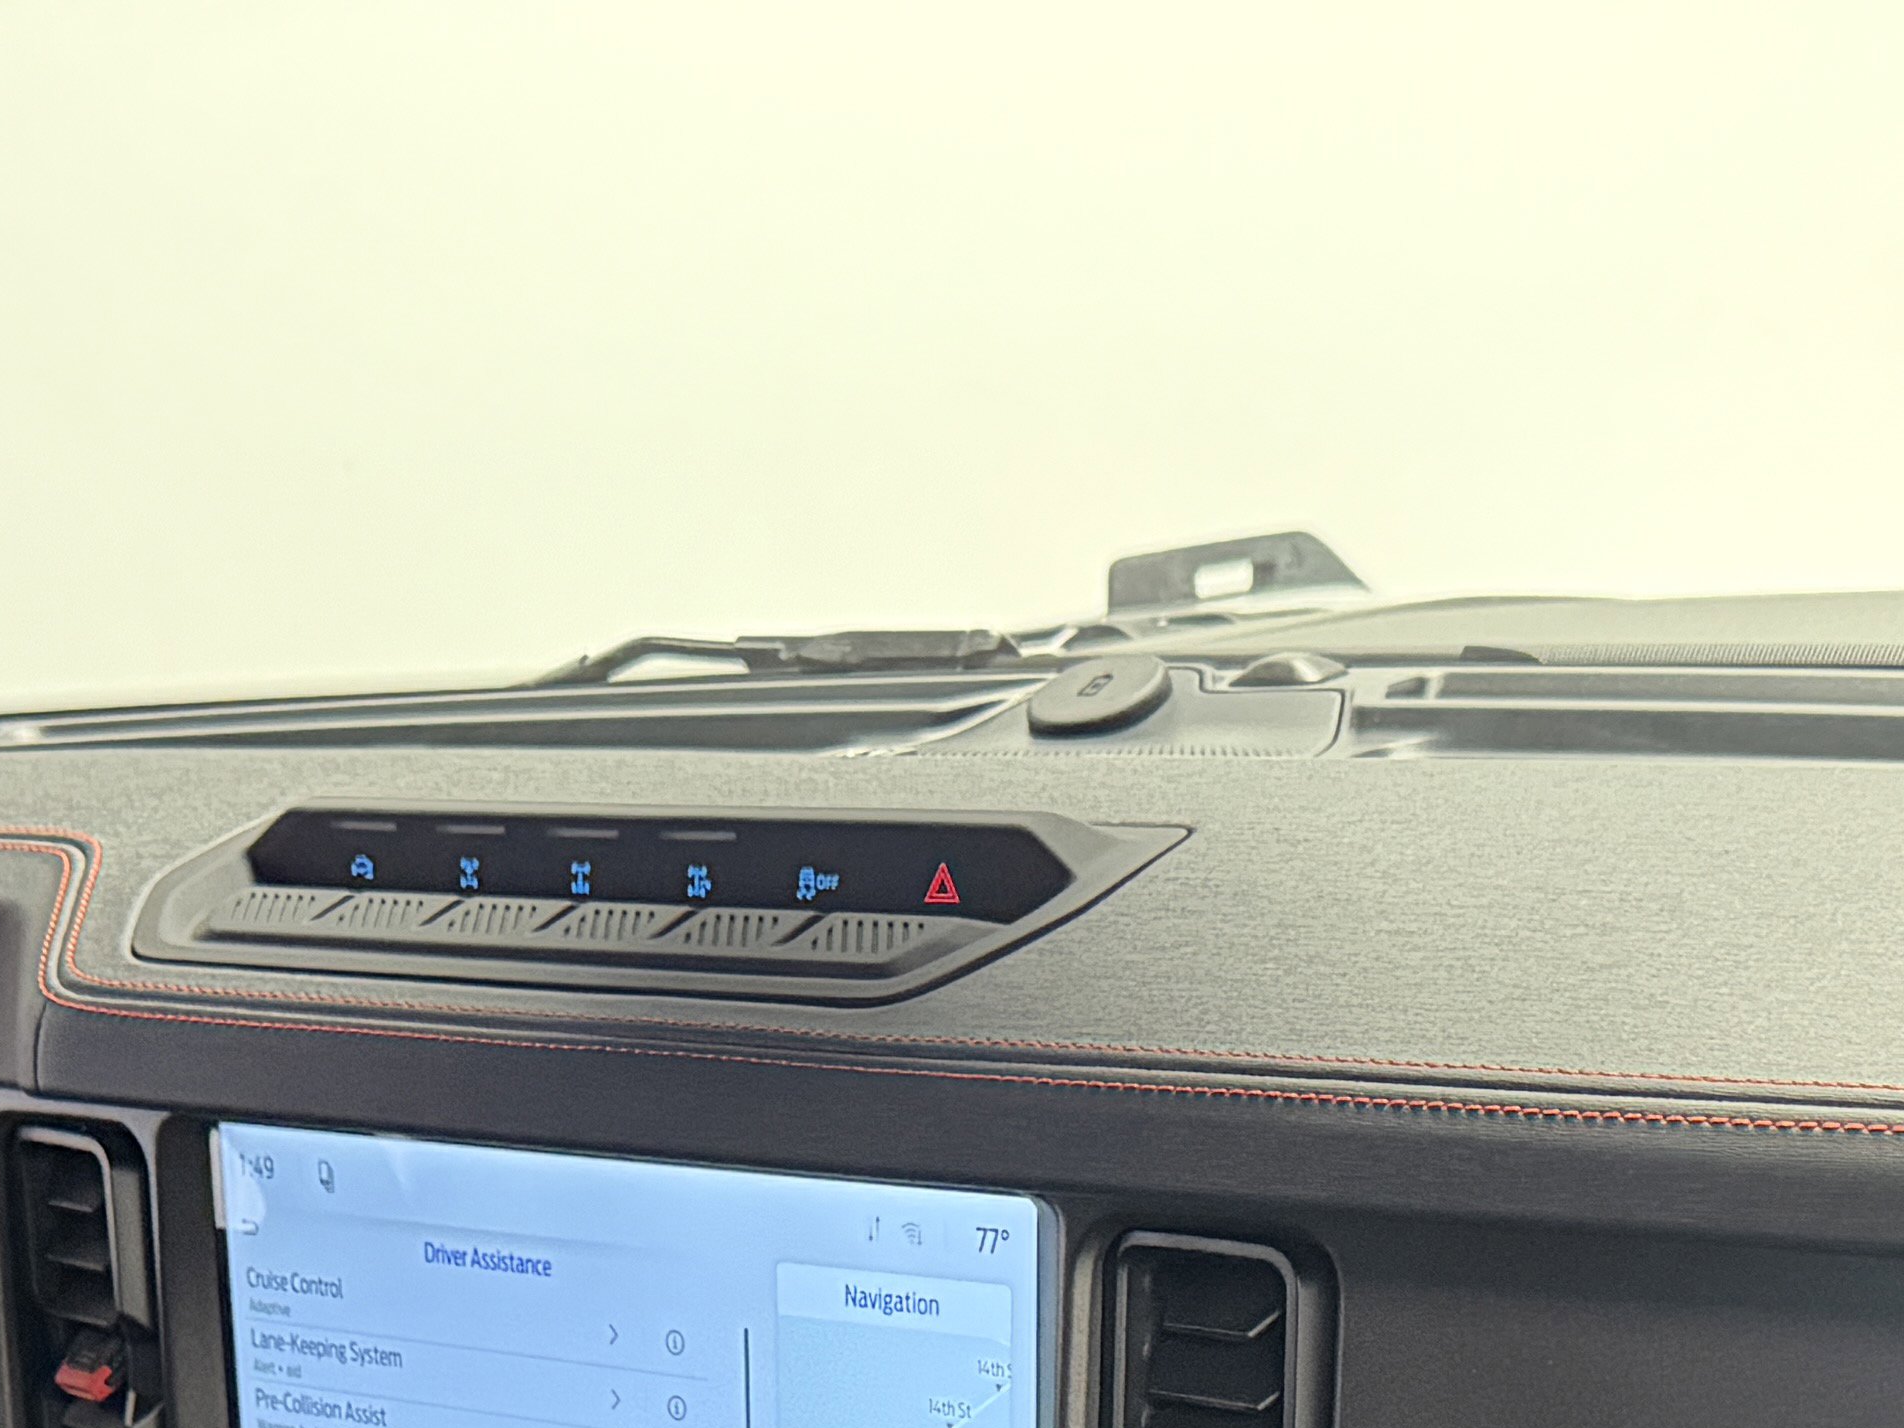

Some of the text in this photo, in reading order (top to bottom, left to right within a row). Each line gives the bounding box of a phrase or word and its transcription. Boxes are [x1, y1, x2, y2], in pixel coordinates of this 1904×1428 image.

[424, 1241, 552, 1277] Driver Assistance
[247, 1266, 344, 1300] Cruise Control
[845, 1283, 940, 1317] Navigation
[250, 1327, 403, 1368] Lane-Keeping System
[255, 1386, 388, 1428] Pre-Collision Assist
[928, 1398, 972, 1420] 14th St
